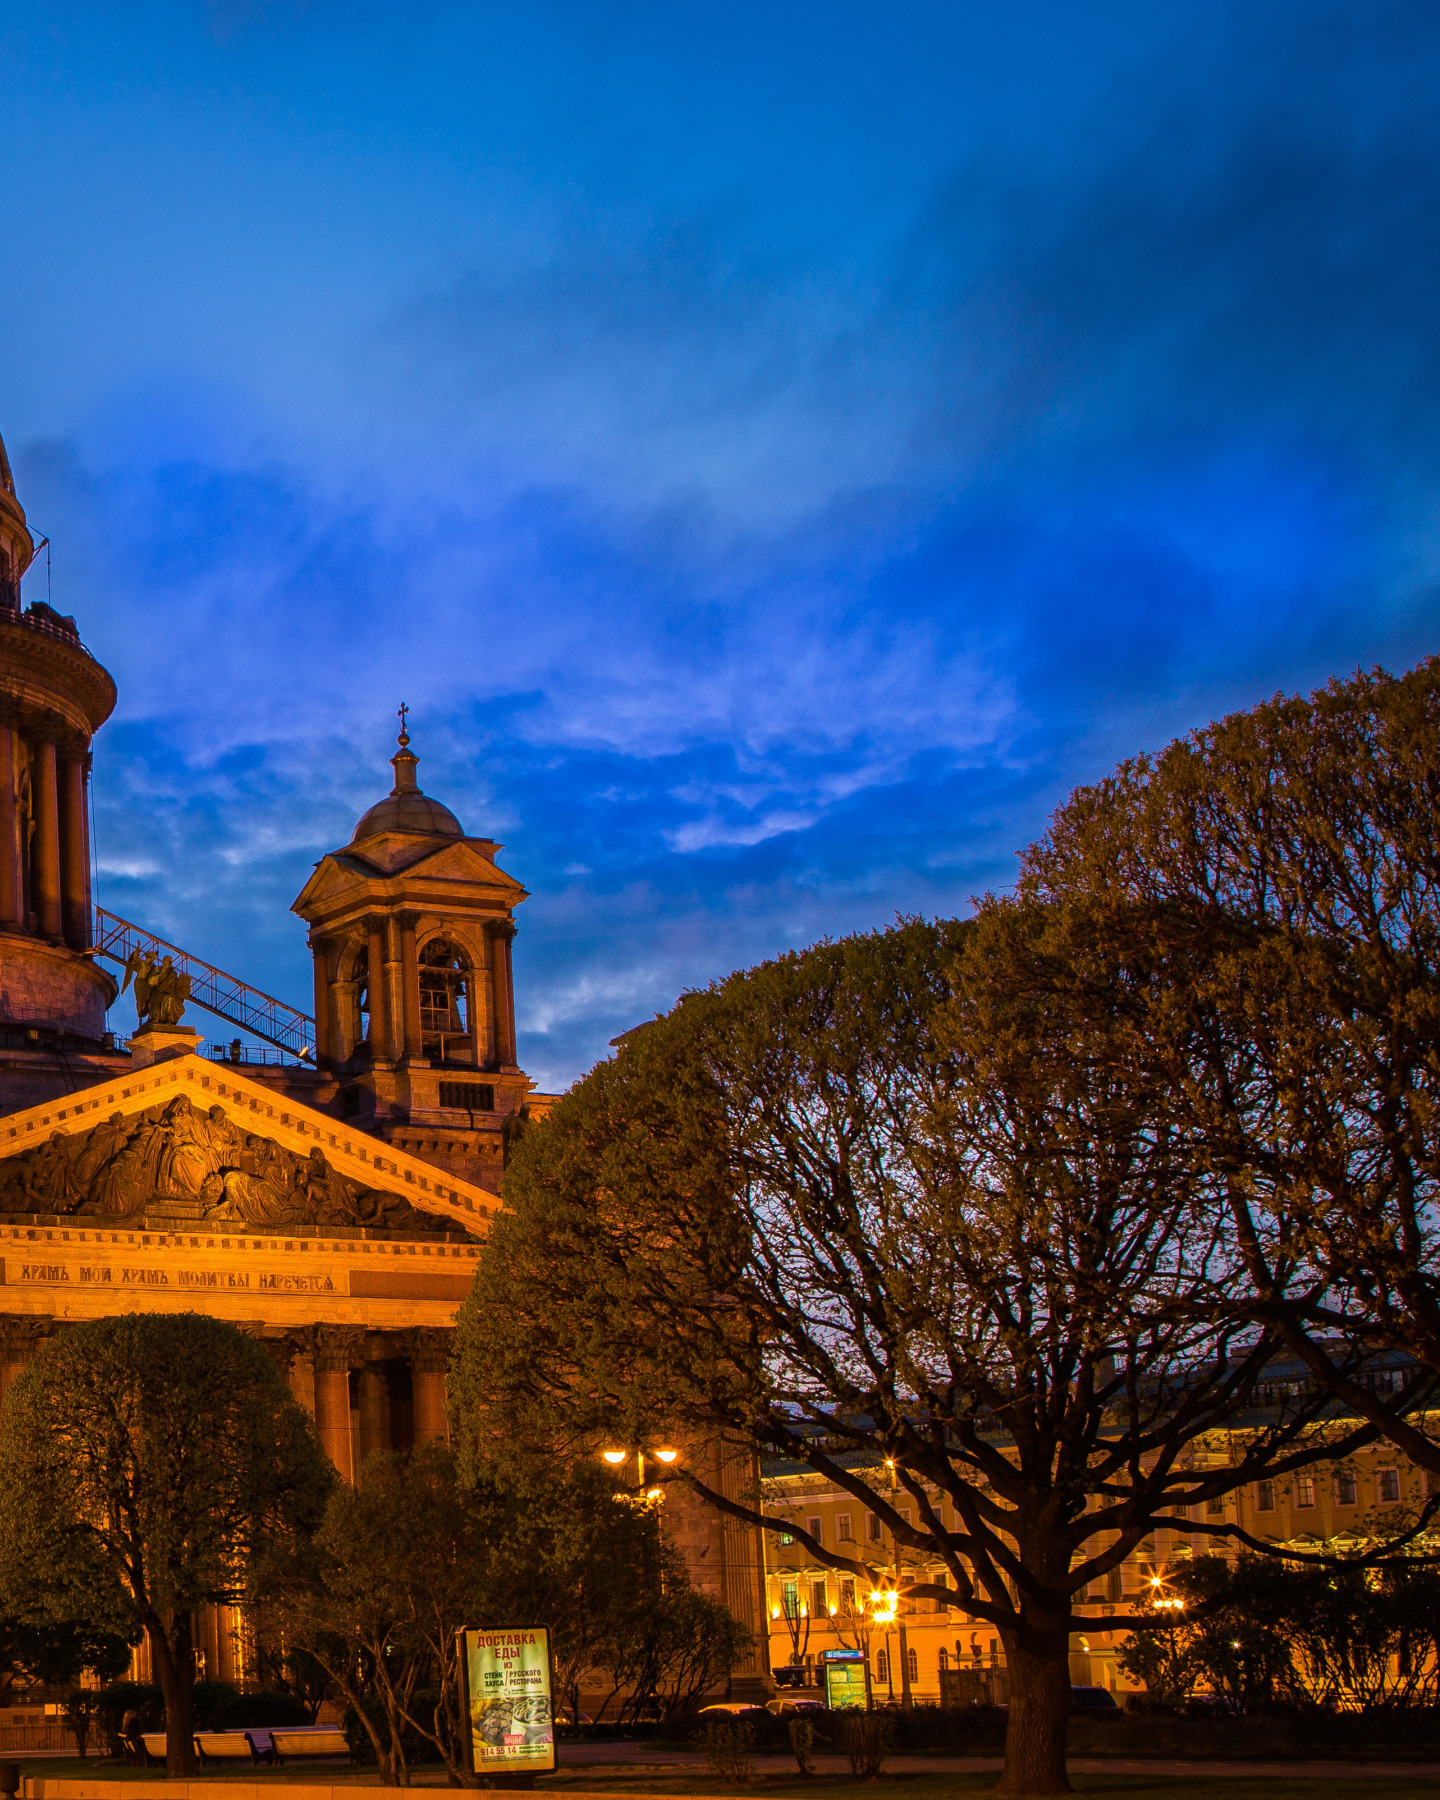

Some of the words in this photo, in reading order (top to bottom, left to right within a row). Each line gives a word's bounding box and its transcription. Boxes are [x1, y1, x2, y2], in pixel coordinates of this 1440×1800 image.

[20, 1264, 69, 1281] ХРАМЪ
[121, 1268, 169, 1284] ХРАМЪ
[477, 1633, 536, 1649] ДОСТАВКА
[494, 1647, 520, 1660] ЕДЫ
[503, 1661, 513, 1669] ИЗ
[484, 1670, 503, 1679] СТЕЙК
[509, 1669, 542, 1677] РУССКОГО
[509, 1677, 542, 1686] РЕСТОРАНА
[480, 1747, 494, 1756] 914
[496, 1746, 505, 1755] 55
[507, 1745, 517, 1754] 14
